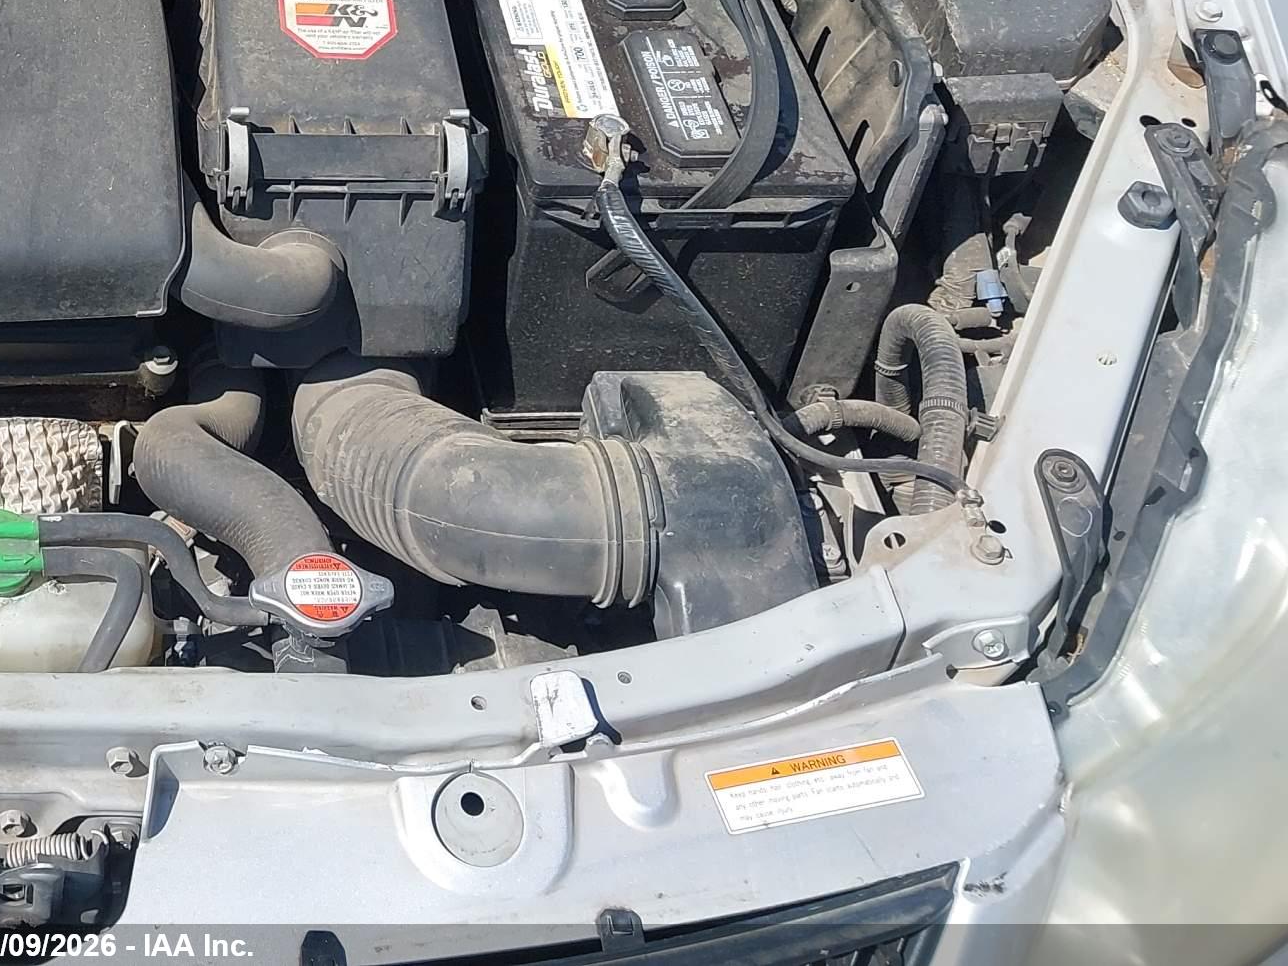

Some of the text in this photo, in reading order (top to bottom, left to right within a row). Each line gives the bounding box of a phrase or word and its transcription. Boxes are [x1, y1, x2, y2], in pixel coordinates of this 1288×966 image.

[536, 51, 552, 78] GOLD
[573, 47, 587, 61] 700
[640, 51, 660, 81] POISON
[518, 48, 554, 112] Duralast
[655, 85, 675, 120] DANGER
[789, 754, 846, 773] WARNING
